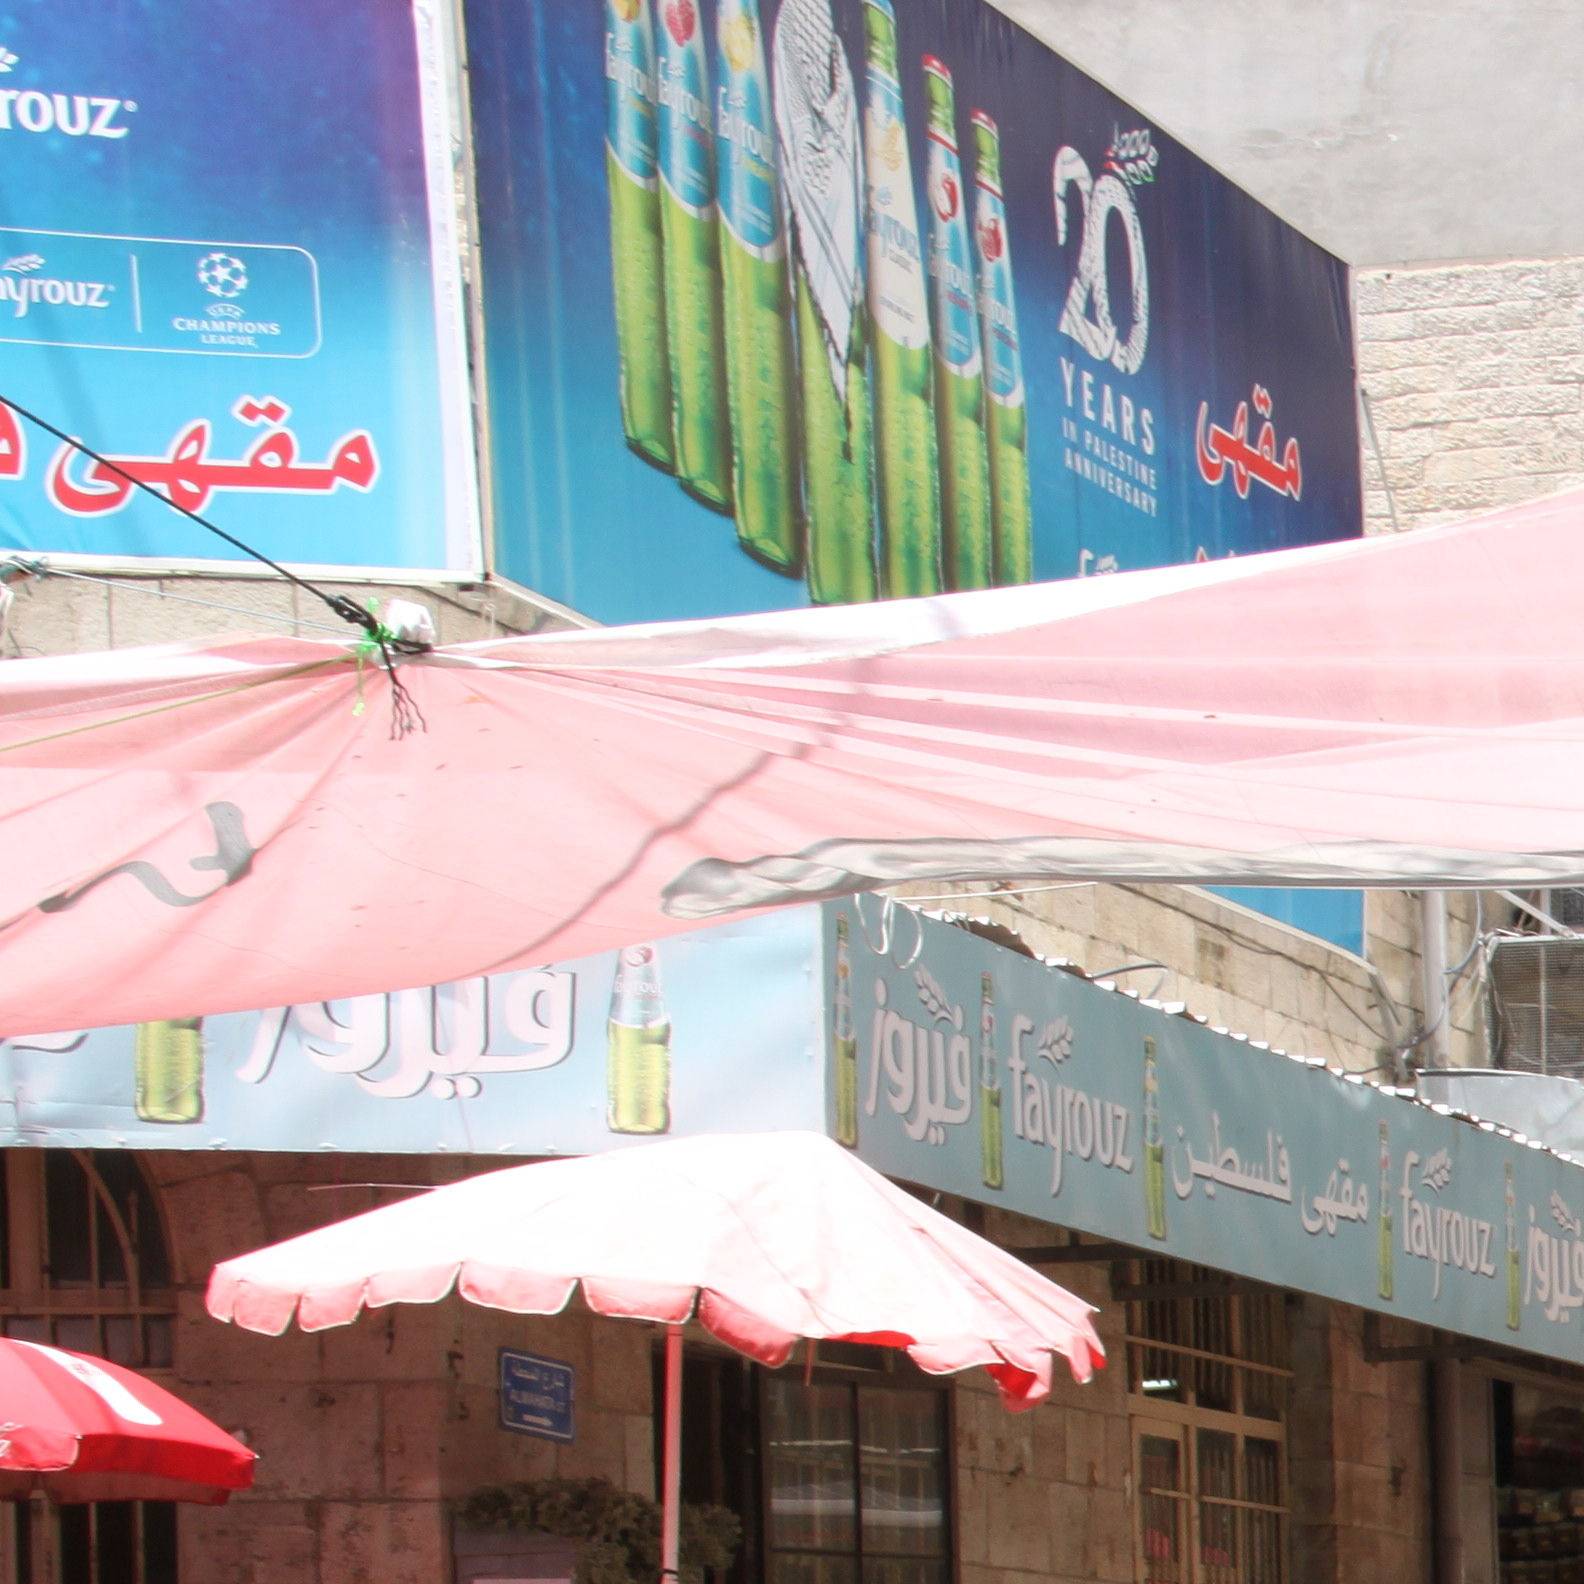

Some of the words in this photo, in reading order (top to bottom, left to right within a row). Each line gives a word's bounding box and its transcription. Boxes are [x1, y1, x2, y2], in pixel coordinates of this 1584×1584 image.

[173, 317, 282, 336] CHAMPIONS
[1060, 356, 1155, 456] YEARS
[1065, 447, 1157, 518] ANNIVERSARY
[1085, 429, 1157, 491] PALESTINE
[865, 978, 973, 1146] فيروز
[1007, 1014, 1134, 1198] fayrouz
[1172, 1110, 1293, 1204] فلسطين
[1300, 1158, 1368, 1237] مقهى
[1400, 1150, 1496, 1300] fayrouz
